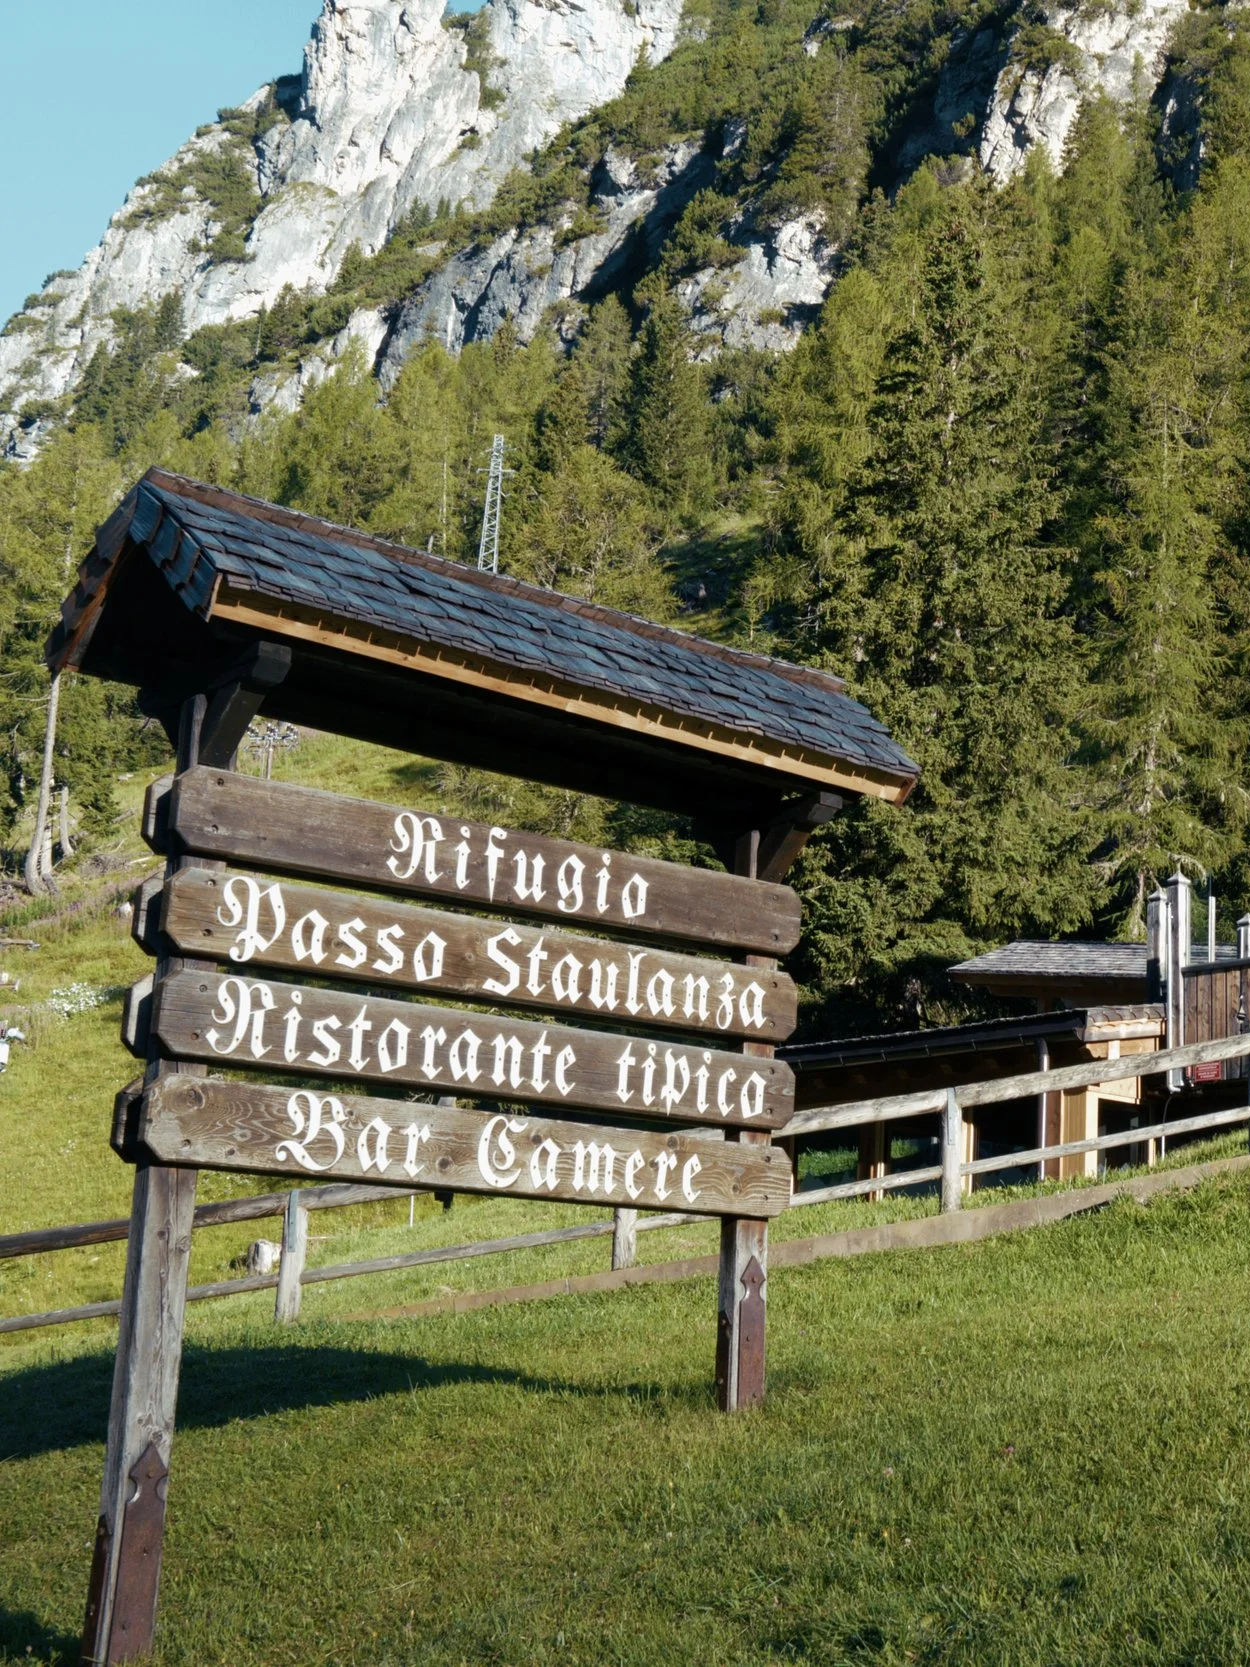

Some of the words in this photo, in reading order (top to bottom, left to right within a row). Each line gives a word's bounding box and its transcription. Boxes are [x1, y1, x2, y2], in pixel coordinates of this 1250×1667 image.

[387, 811, 649, 918] Rifugio
[216, 876, 447, 981] Passo
[482, 926, 767, 1029] Staulanza
[205, 978, 576, 1096] Ristorante
[612, 1041, 767, 1119] tipico
[276, 1091, 431, 1178] Bar
[477, 1115, 702, 1203] Camere
